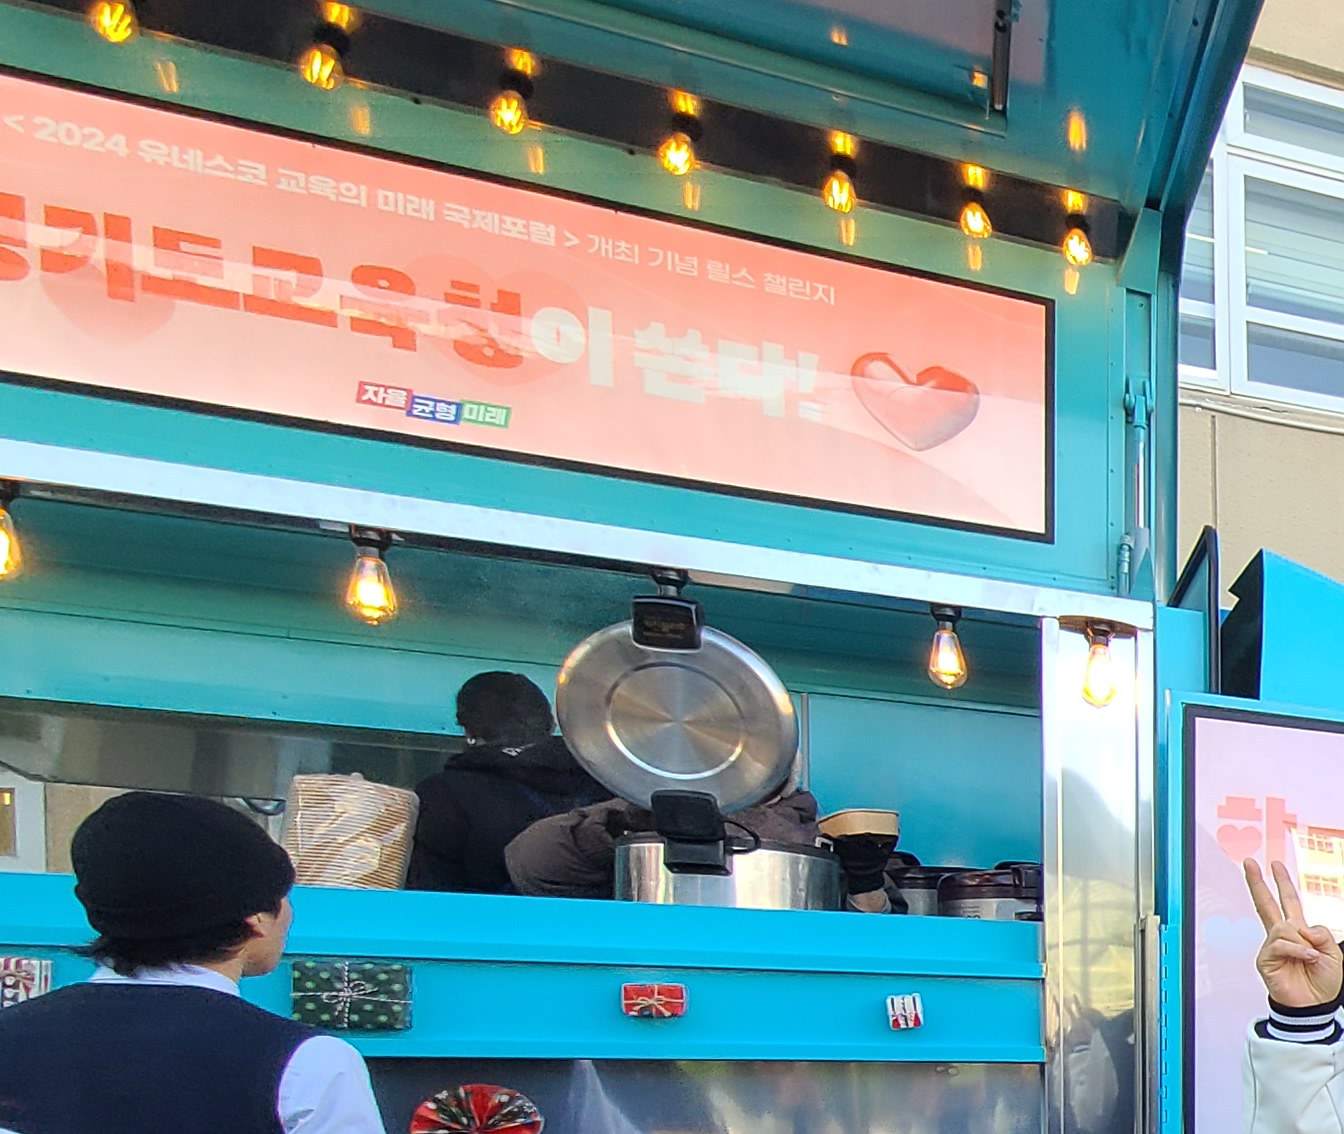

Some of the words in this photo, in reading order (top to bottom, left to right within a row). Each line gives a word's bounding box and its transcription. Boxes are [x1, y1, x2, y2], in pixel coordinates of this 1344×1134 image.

[33, 117, 129, 158] 2024
[137, 139, 268, 186] 유네스코
[276, 167, 368, 208] 교육의
[377, 188, 436, 221] 미래
[442, 202, 557, 248] 국제포럼
[587, 234, 639, 265] 개최
[648, 247, 698, 277] 기념
[706, 259, 756, 290] 릴스
[762, 272, 836, 306] 챌린지
[361, 384, 408, 409] 자율
[412, 397, 458, 422] 균형
[463, 402, 507, 426] 미래
